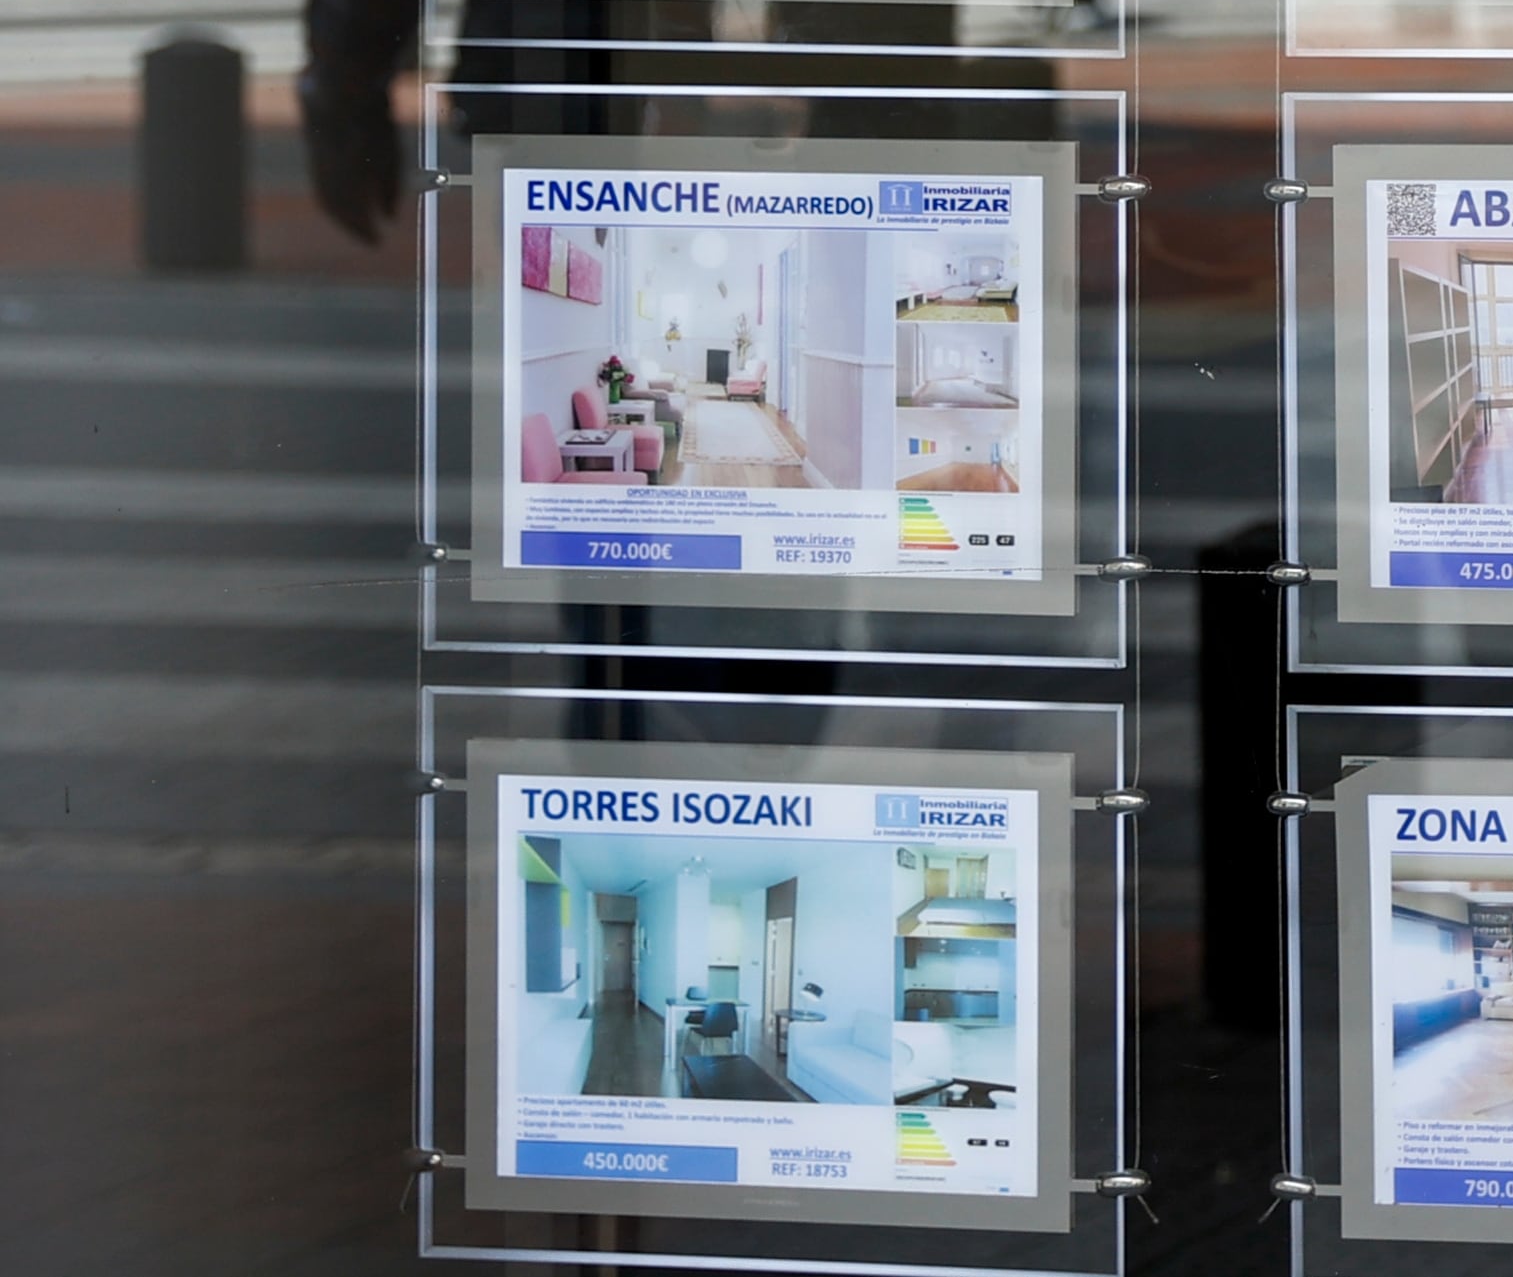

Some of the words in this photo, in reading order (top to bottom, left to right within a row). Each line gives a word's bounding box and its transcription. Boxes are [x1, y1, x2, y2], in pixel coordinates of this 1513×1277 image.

[923, 186, 1010, 197] Inmobiliaria
[527, 180, 720, 213] ENSANCHE
[727, 194, 873, 219] (MAZARREDO)
[923, 198, 1009, 212] IRIZAR
[773, 533, 855, 545] www.irizar.es
[588, 542, 672, 560] 770.000€
[776, 550, 805, 562] REF:
[810, 550, 851, 563] 19370
[521, 788, 659, 822] TORRES
[672, 792, 811, 827] ISOZAKI
[920, 800, 1007, 811] Inmobiliaria
[920, 812, 1005, 826] IRIZAR
[1396, 808, 1507, 843] ZONA
[770, 1147, 851, 1159] www.irizar.es
[583, 1152, 669, 1172] 450.000€
[772, 1164, 801, 1176] REF:
[806, 1164, 847, 1177] 18753
